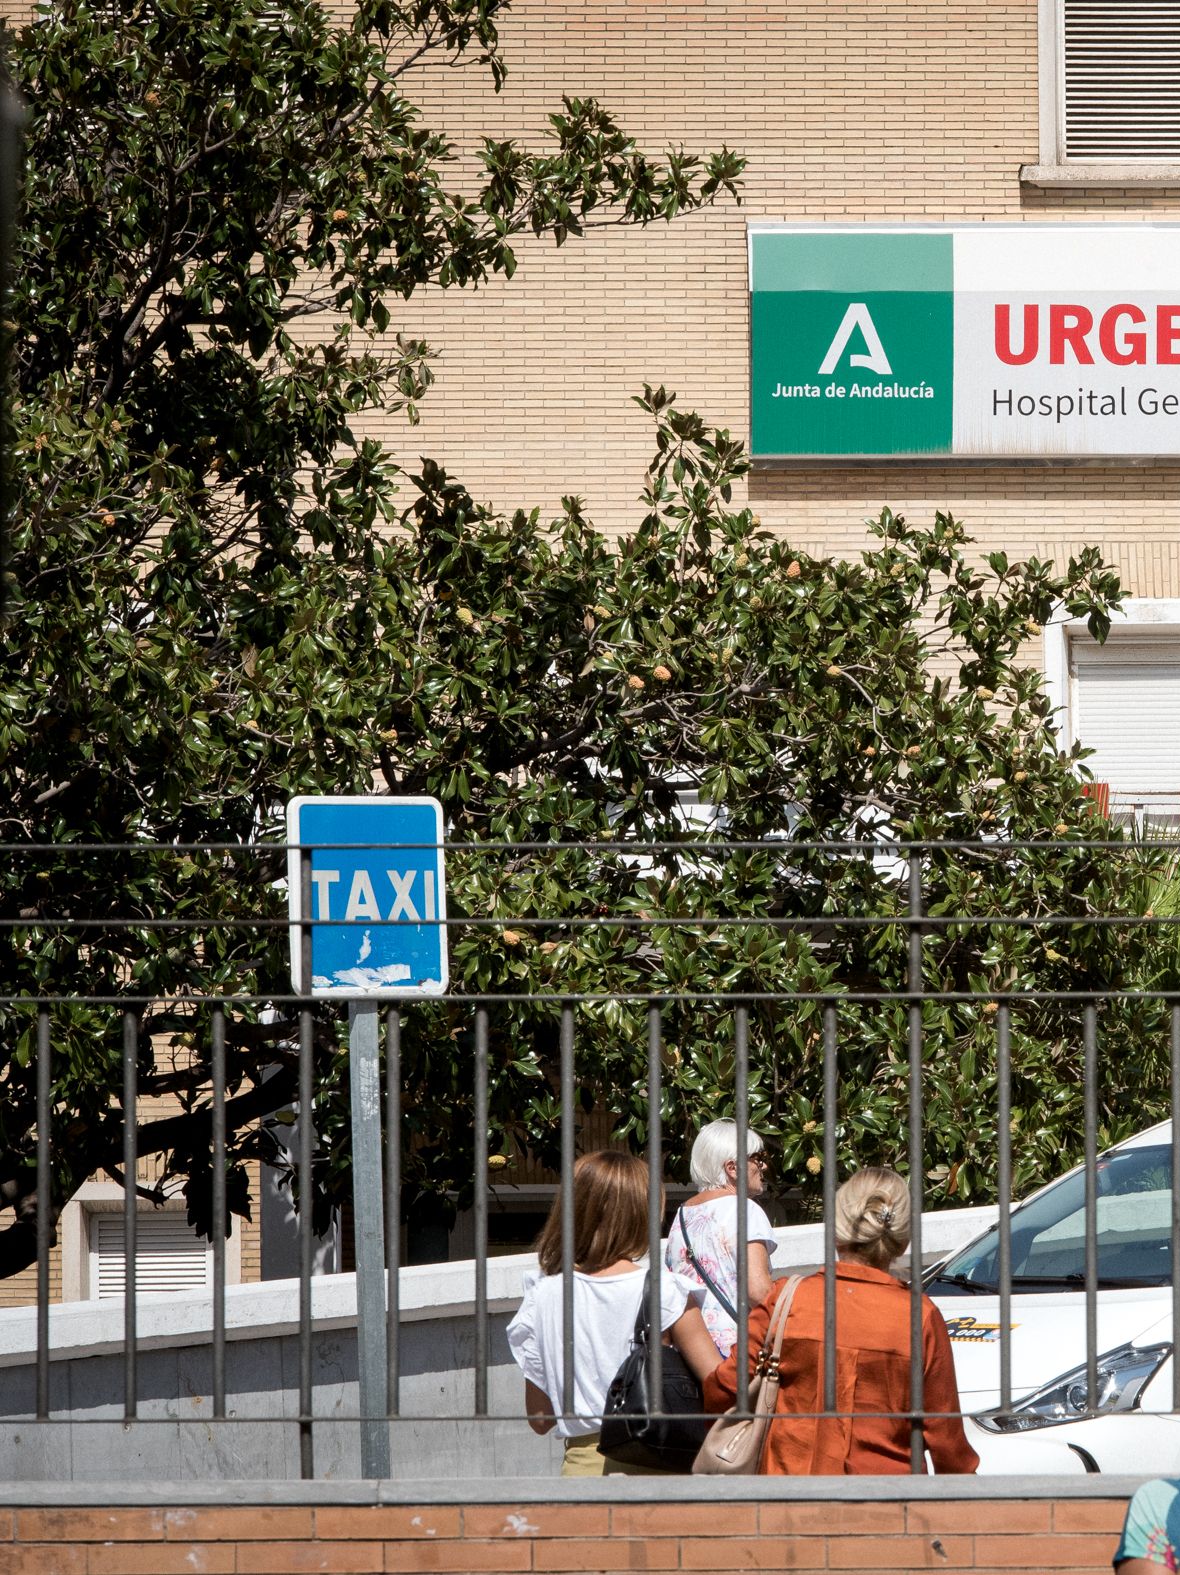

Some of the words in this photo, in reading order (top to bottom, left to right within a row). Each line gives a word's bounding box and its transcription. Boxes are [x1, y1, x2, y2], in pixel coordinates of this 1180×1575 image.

[771, 383, 821, 398] Junta
[825, 382, 846, 398] de
[850, 381, 934, 398] Andalucía
[992, 386, 1127, 424] Hospital
[311, 870, 436, 922] TAXI
